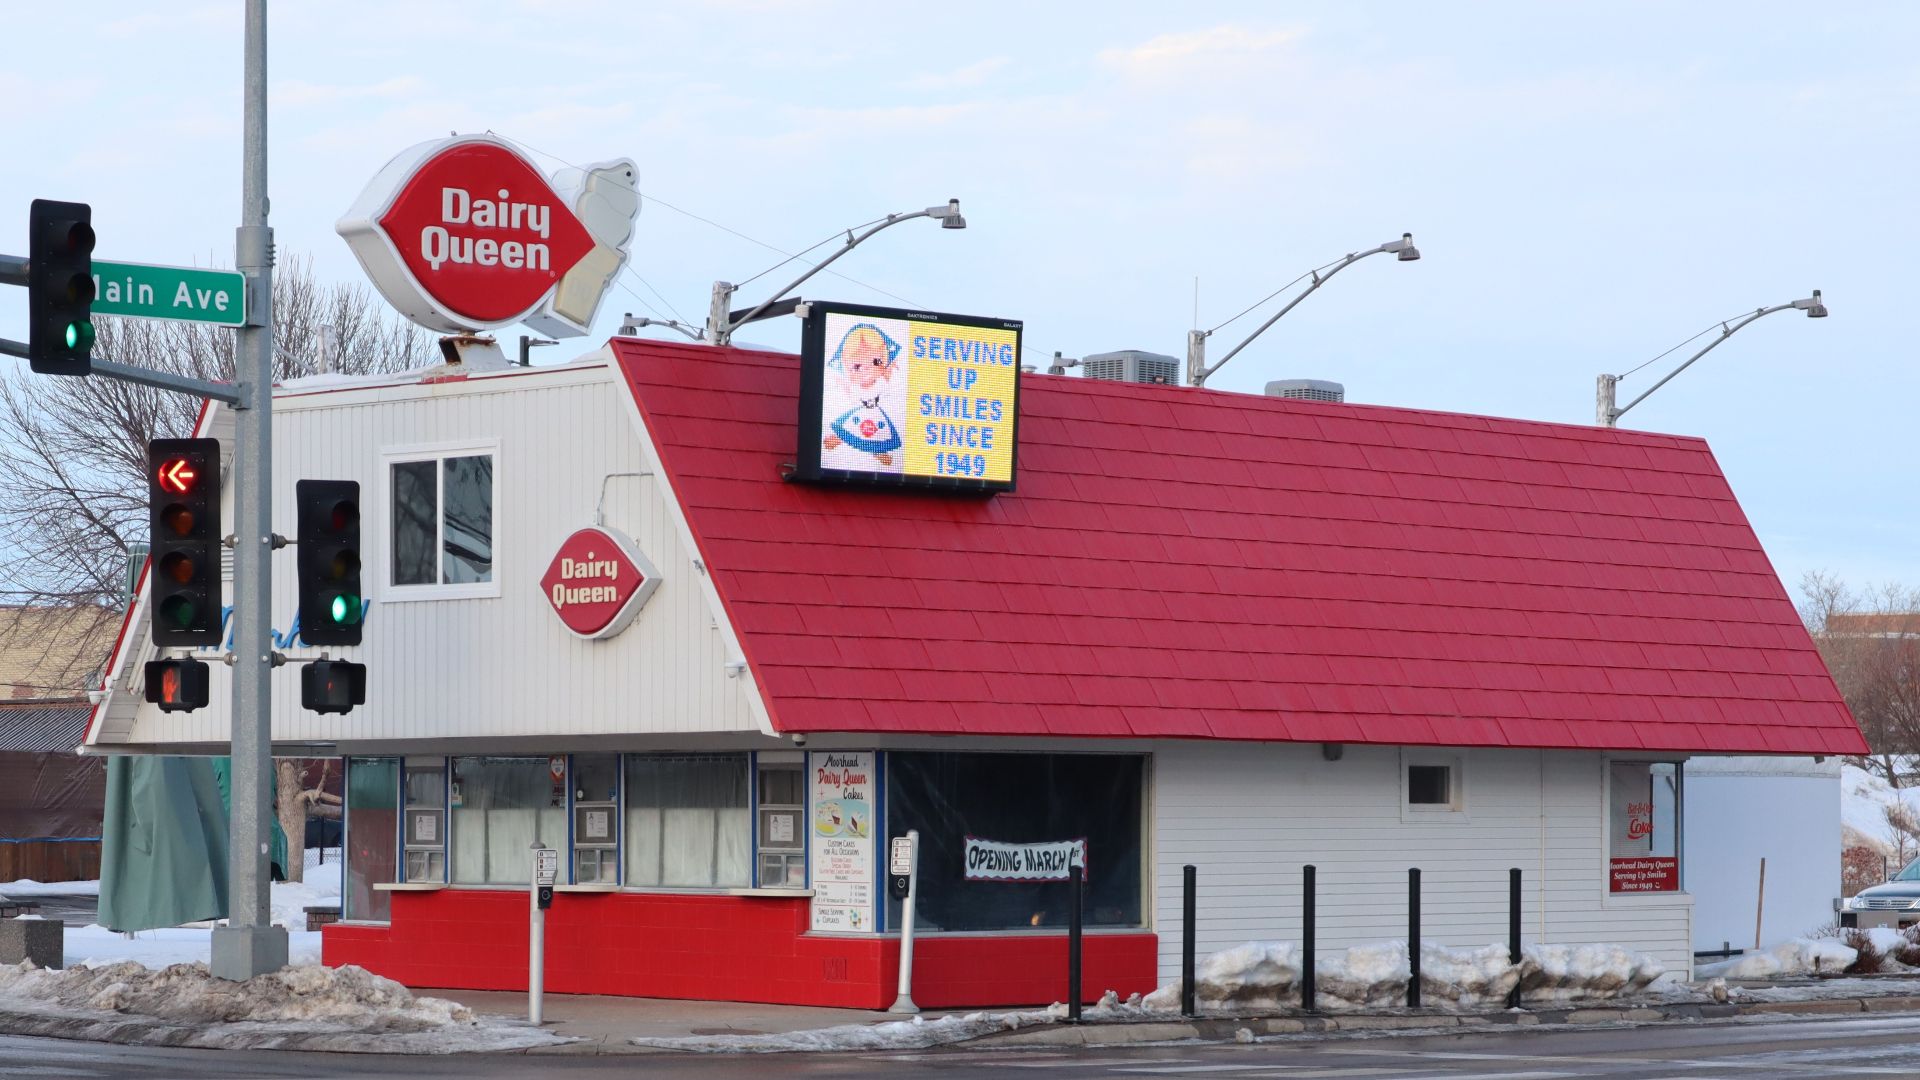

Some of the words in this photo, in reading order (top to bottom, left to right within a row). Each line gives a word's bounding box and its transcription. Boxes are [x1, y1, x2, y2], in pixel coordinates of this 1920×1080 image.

[442, 187, 550, 238] Dairy
[421, 225, 550, 271] Queen
[173, 281, 229, 311] Ave
[913, 335, 1014, 366] SERVING
[948, 367, 978, 391] UP
[920, 393, 1003, 422] SMILES
[925, 422, 994, 450] SINCE
[936, 452, 986, 477] 1949
[561, 551, 618, 580] Dairy
[552, 584, 617, 610] Queen
[824, 754, 859, 767] Moorhead
[818, 768, 841, 788] Dairy
[842, 768, 867, 786] Queen
[843, 787, 864, 800] Cakes
[969, 845, 1021, 872] OPENING
[1024, 848, 1066, 872] MARCH
[1637, 861, 1655, 870] Dairy
[1655, 861, 1675, 869] Queen
[1614, 871, 1637, 880] Serving
[1638, 871, 1646, 880] Up
[1647, 870, 1667, 878] Smiles
[1622, 881, 1638, 890] Since
[1639, 882, 1653, 890] 1949
